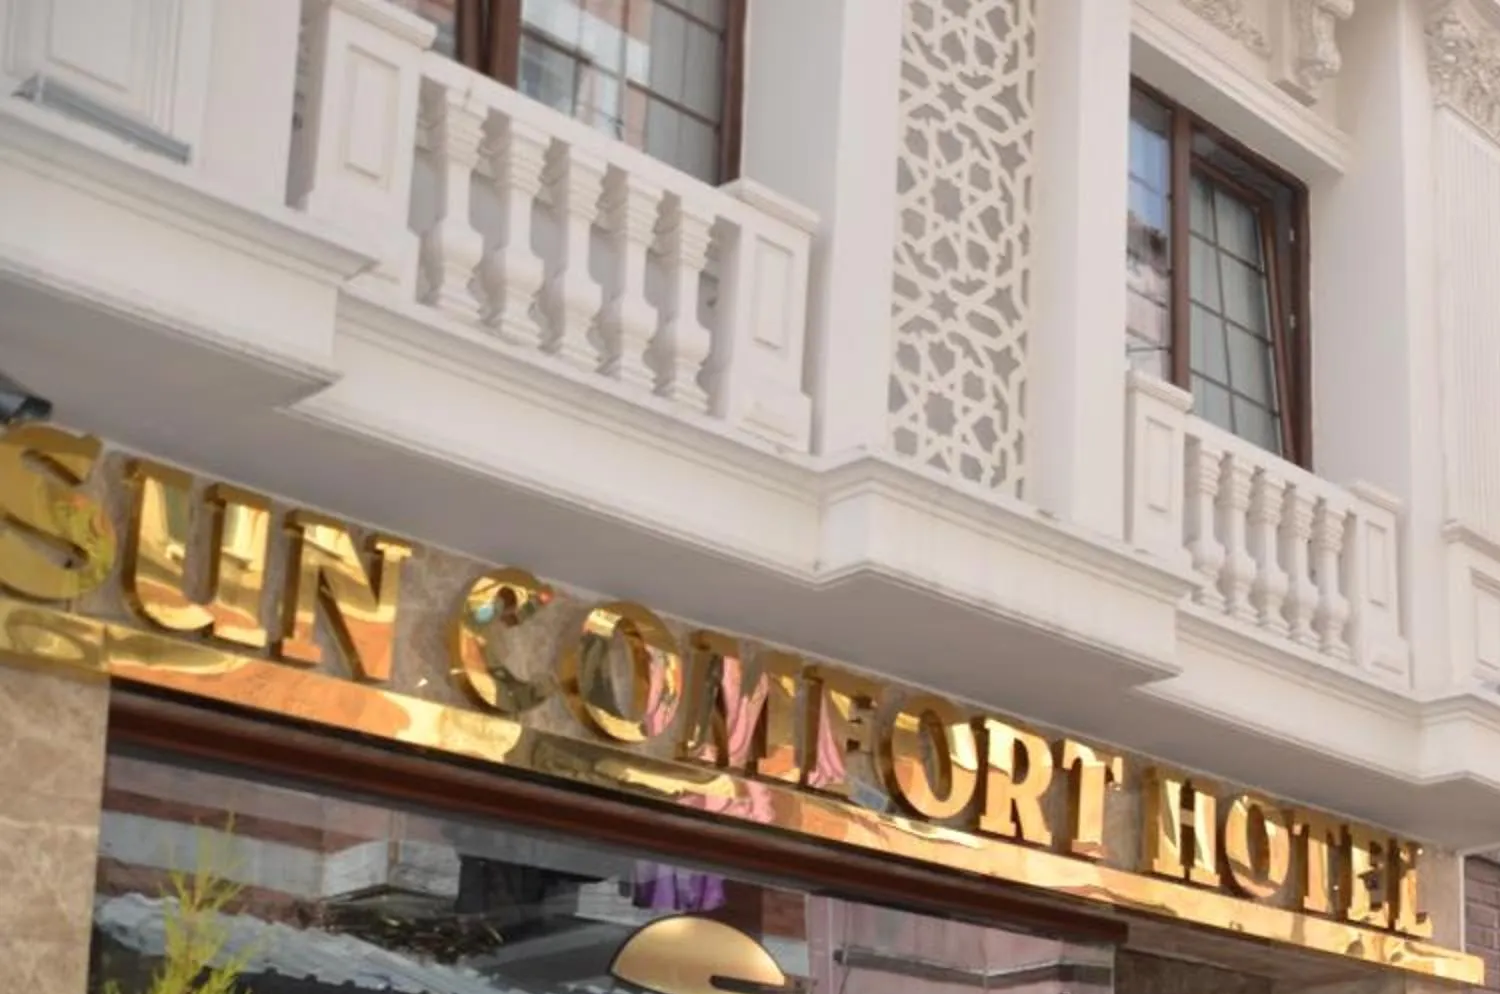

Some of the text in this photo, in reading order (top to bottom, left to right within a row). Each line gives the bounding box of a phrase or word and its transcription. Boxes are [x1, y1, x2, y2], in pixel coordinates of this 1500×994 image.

[0, 422, 1434, 939] SUN COMFORT HOTEL
